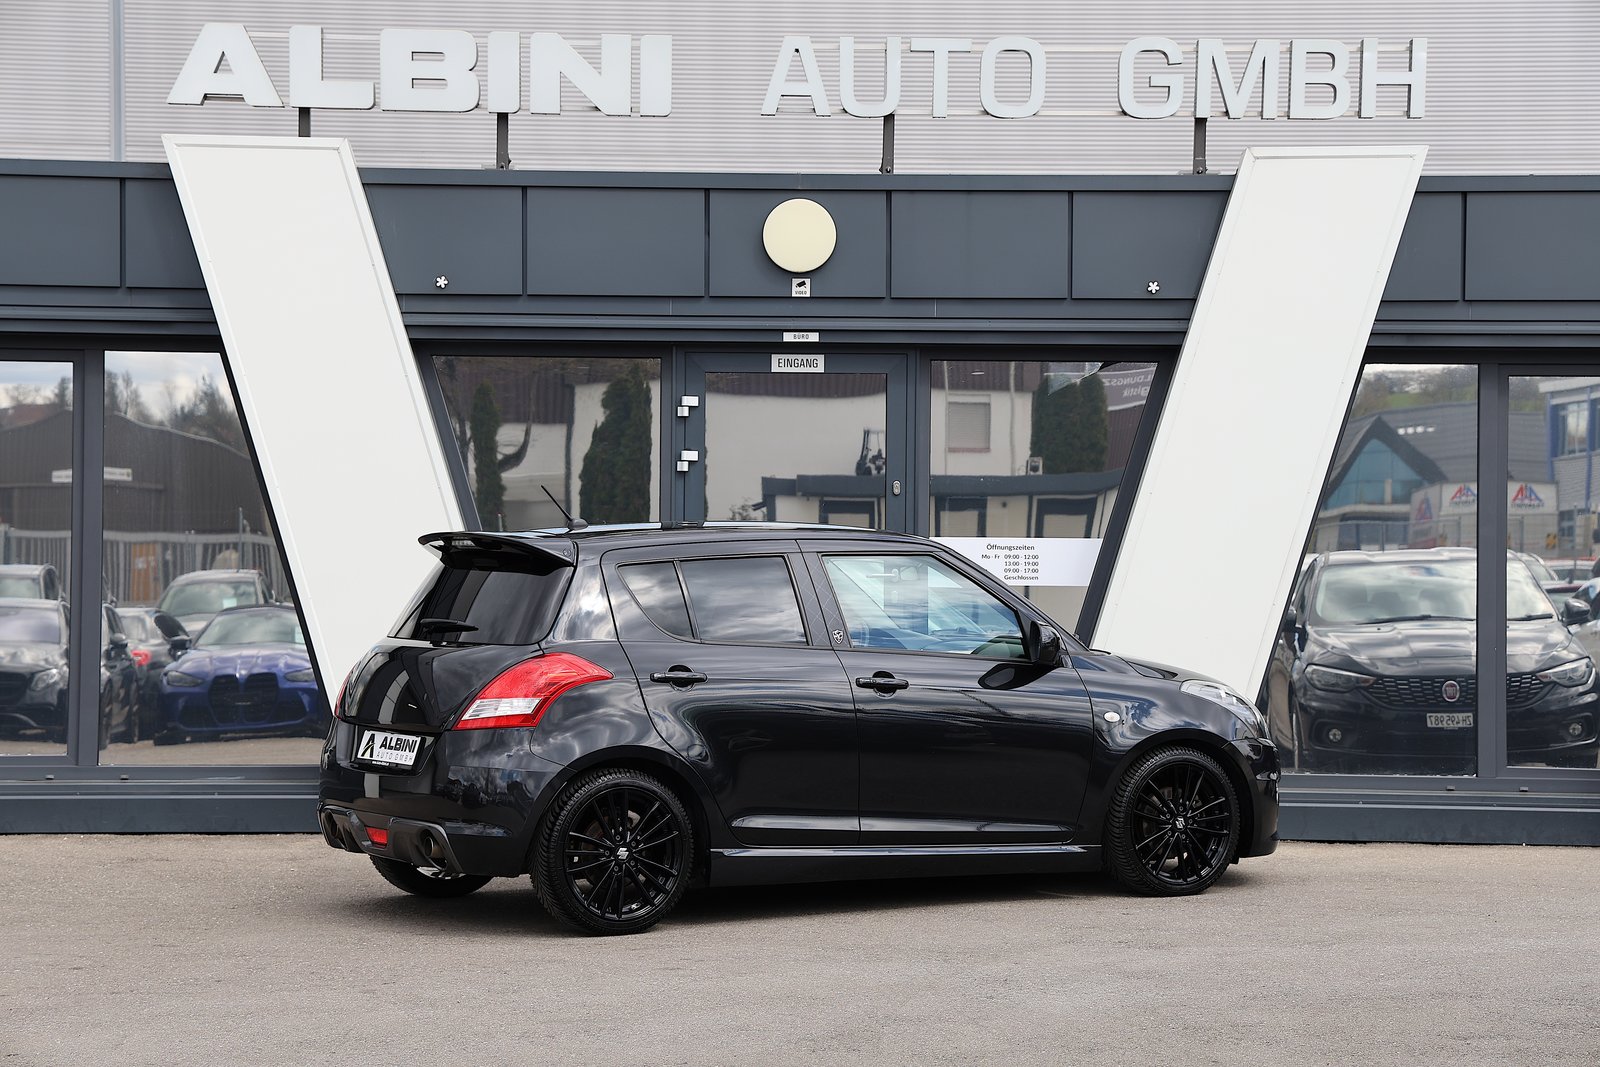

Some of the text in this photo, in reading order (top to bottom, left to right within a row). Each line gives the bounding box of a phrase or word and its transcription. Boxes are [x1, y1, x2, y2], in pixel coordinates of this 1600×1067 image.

[167, 23, 1429, 120] ALBINI AUTO GMBH
[777, 358, 819, 368] EINGANG
[986, 543, 1035, 551] Öffnungszeiten
[379, 736, 418, 753] ALBINI
